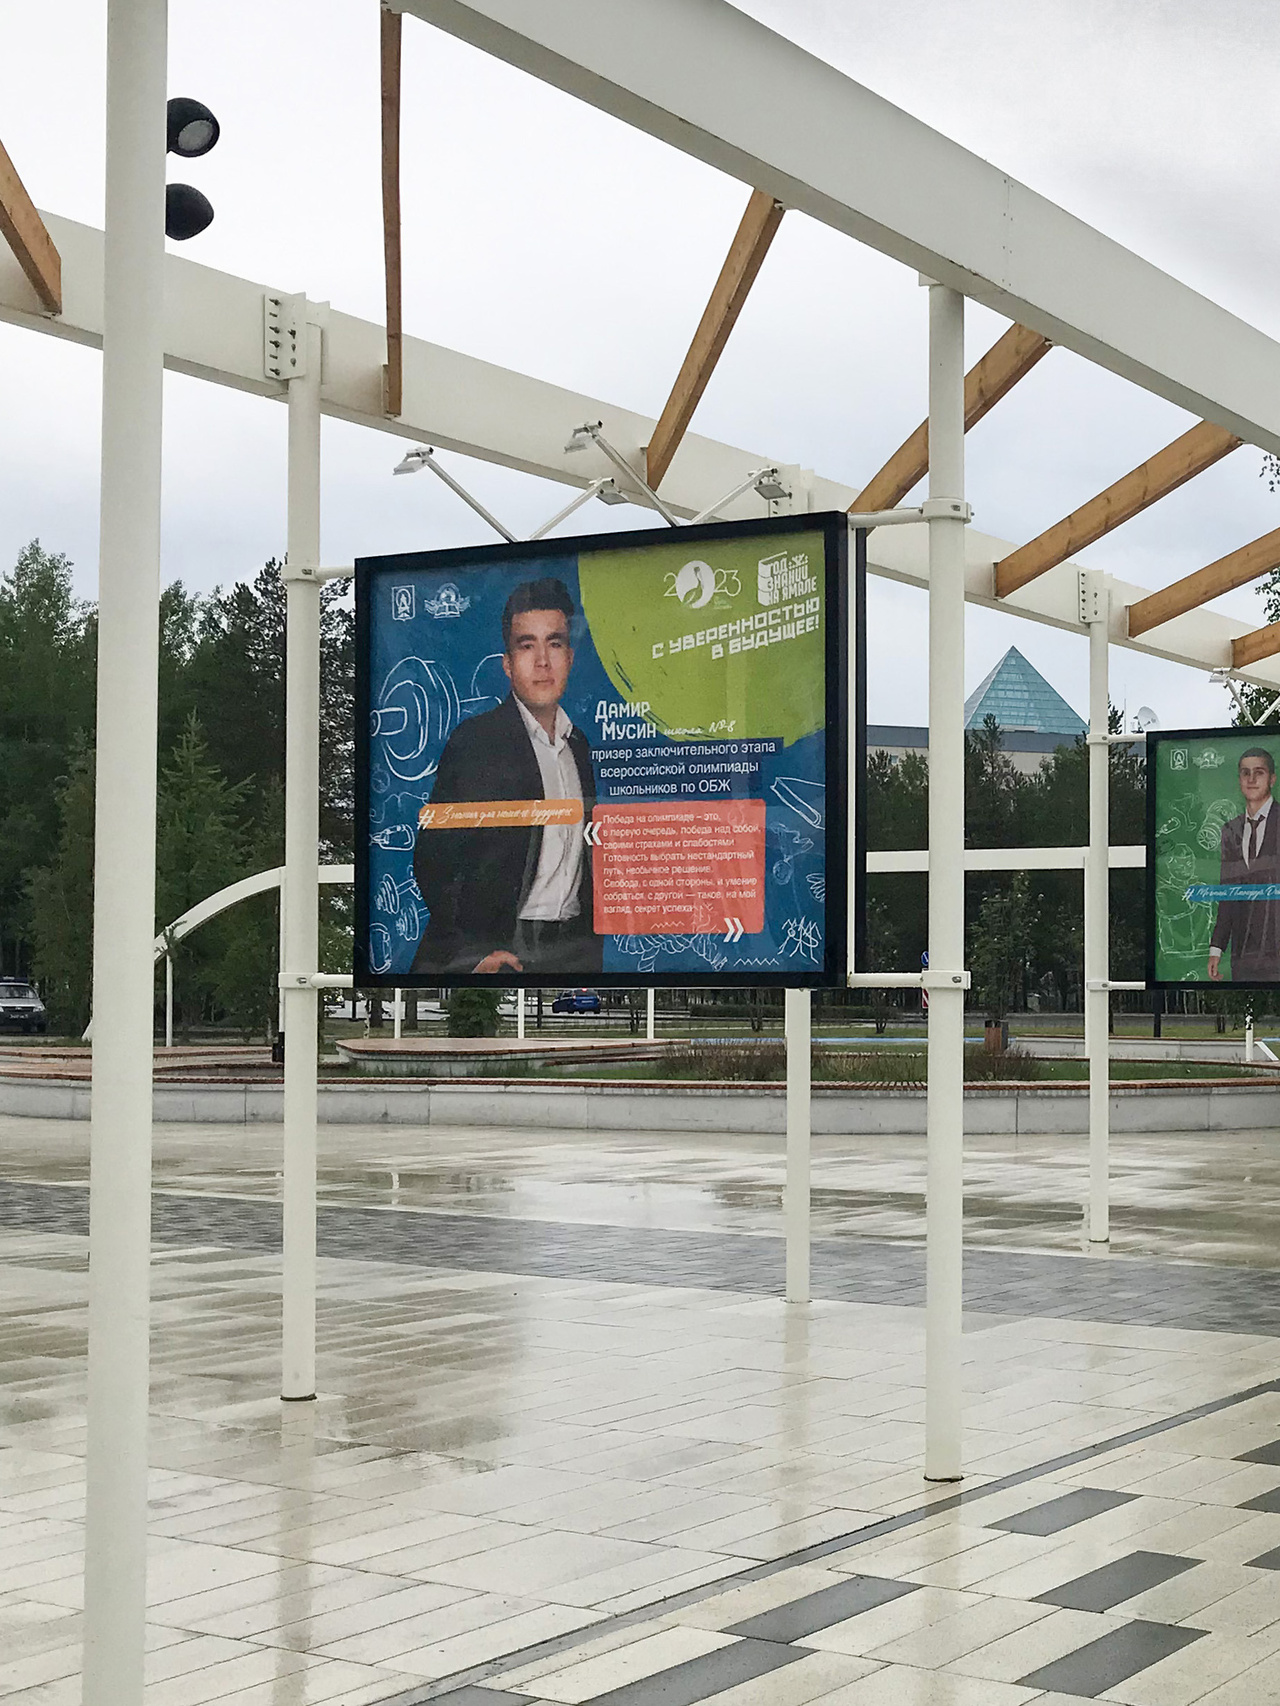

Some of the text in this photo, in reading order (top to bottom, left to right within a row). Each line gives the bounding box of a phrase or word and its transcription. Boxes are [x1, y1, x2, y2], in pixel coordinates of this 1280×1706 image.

[782, 576, 817, 602] ЯМАЛЕ
[652, 596, 820, 660] С УВЕРЕННОСТЬЮ
[711, 614, 820, 660] В БУДУЩЕЕ!
[591, 741, 776, 763] призер заключительного этапа
[600, 760, 759, 780] всероссийской олимпиады
[609, 778, 731, 797] школьников по ОБЖ
[603, 814, 634, 825] Победа
[636, 815, 646, 823] на
[647, 813, 694, 824] олимпиаде
[603, 829, 608, 837] в
[610, 828, 642, 839] первую
[680, 825, 712, 835] победа
[714, 826, 731, 835] над
[603, 842, 634, 850] своими
[635, 840, 673, 851] страхами
[682, 838, 734, 848] слабостями
[603, 849, 754, 862] Готовность выбрать нестандартный
[625, 866, 670, 875] необычное
[649, 877, 674, 888] одной
[717, 878, 723, 886] и
[725, 876, 757, 888] умение
[647, 892, 653, 900] с
[653, 890, 683, 902] другой
[726, 891, 737, 899] на
[738, 888, 757, 899] мой
[634, 904, 661, 914] секрет
